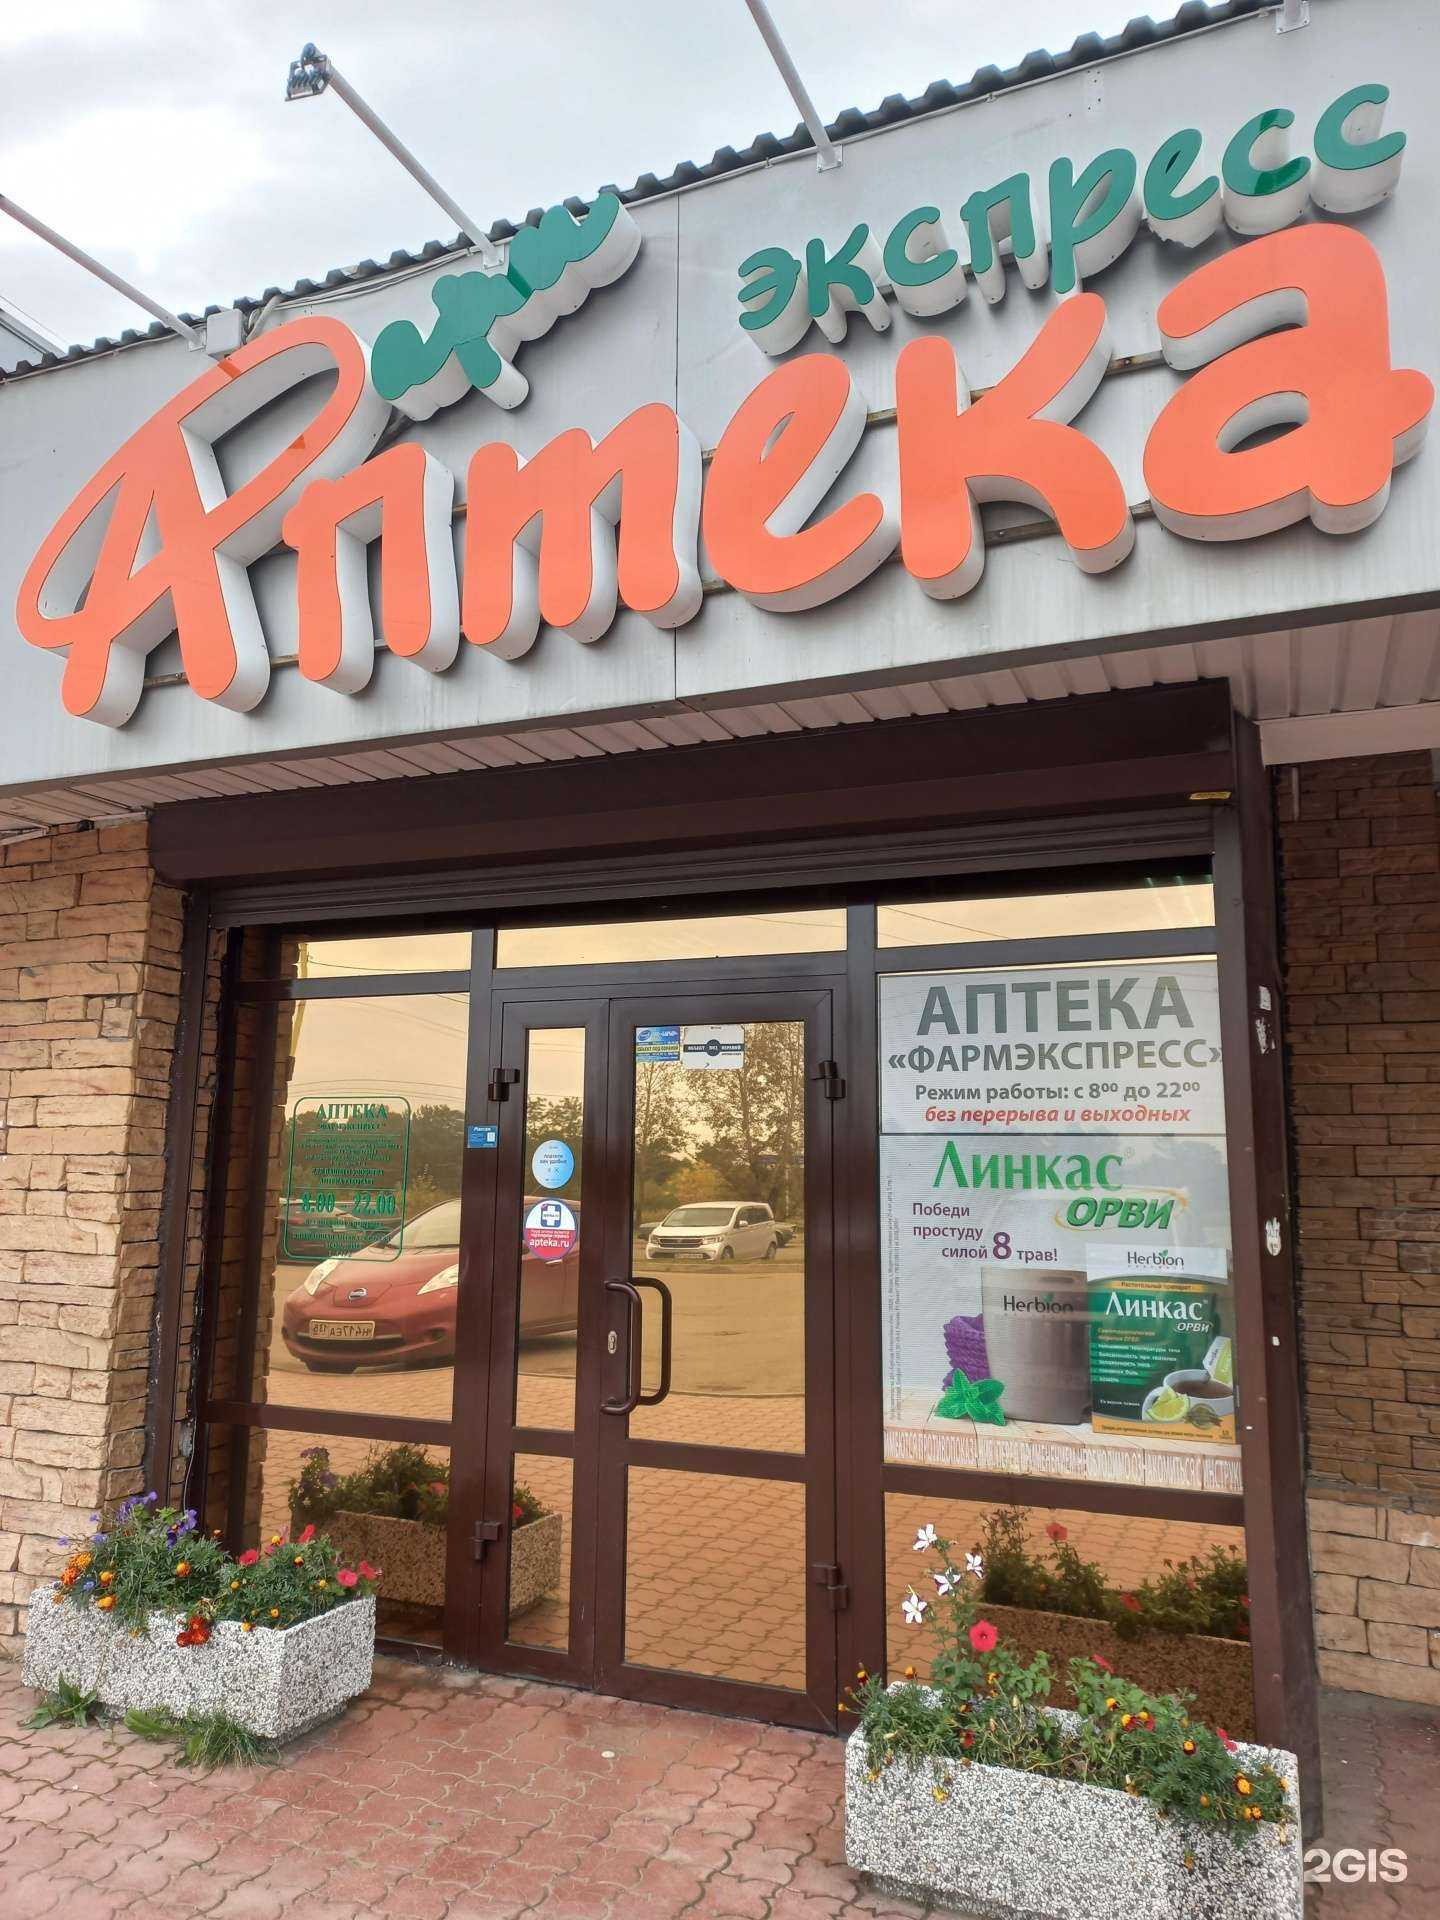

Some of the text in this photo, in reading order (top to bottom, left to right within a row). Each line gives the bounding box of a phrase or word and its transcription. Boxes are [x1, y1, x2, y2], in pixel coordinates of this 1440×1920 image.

[737, 84, 1407, 332] экспресс
[16, 222, 1435, 718] Аптека
[917, 976, 1195, 1036] АПТЕКА
[888, 1039, 1222, 1073] «ФАРМЭКСПРЕСС»
[916, 1084, 981, 1101] Режим
[987, 1083, 1068, 1103] работы:
[1074, 1087, 1084, 1099] с
[1123, 1085, 1150, 1102] до
[316, 1103, 388, 1120] АПТЕКА
[925, 1105, 1191, 1125] без перерыва и выходных
[932, 1140, 1123, 1191] Линкас
[912, 1202, 970, 1217] Победи
[1066, 1196, 1175, 1229] ОРВИ
[912, 1225, 983, 1240] простуду
[529, 1238, 570, 1249] apteka.ru
[942, 1231, 1058, 1263] силой 8 трав!
[1127, 1250, 1184, 1266] Herbion
[1003, 1295, 1074, 1314] Herbion
[1105, 1291, 1203, 1321] Линкас
[1177, 1322, 1210, 1333] ОРВИ
